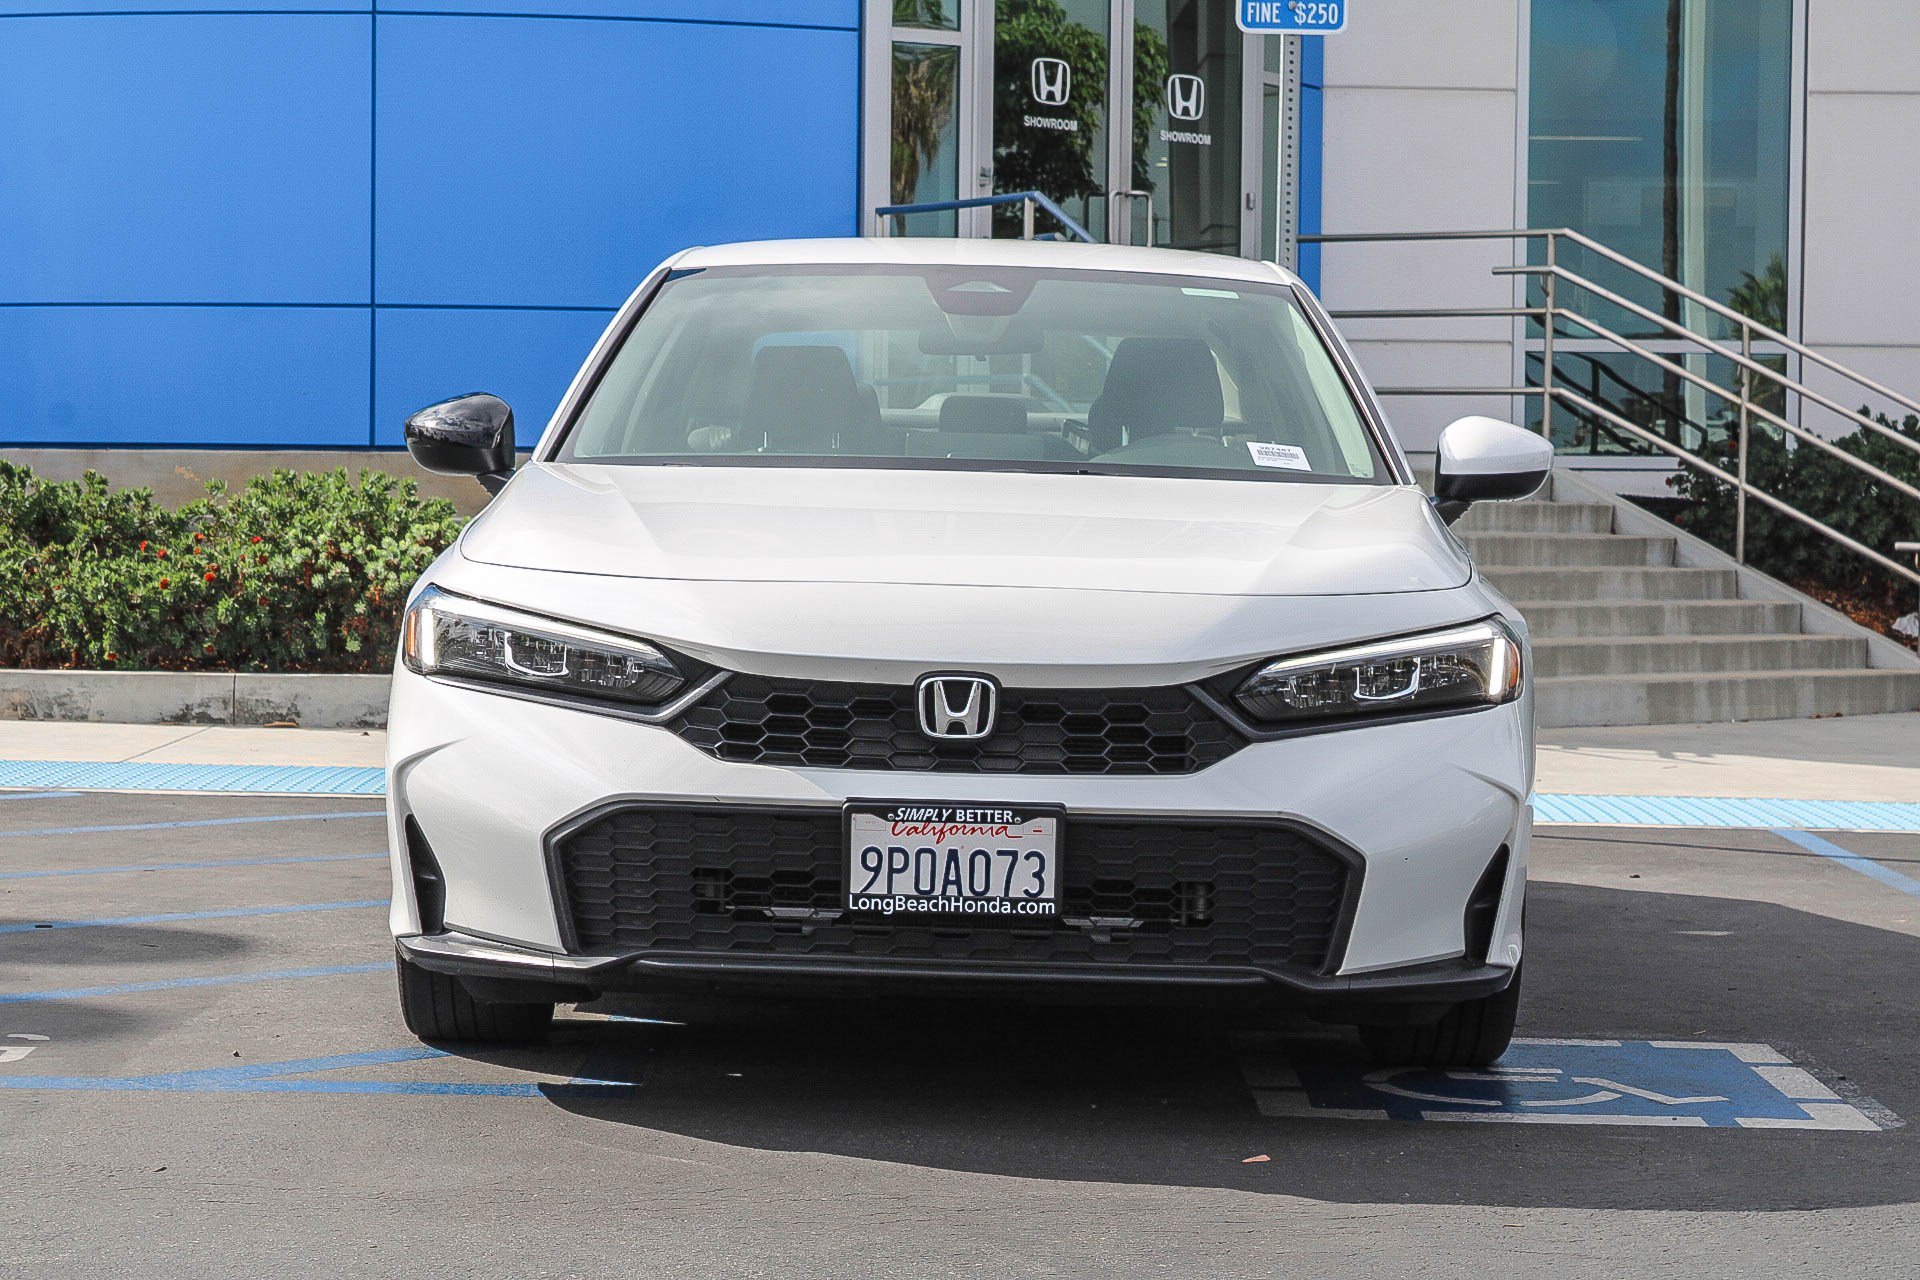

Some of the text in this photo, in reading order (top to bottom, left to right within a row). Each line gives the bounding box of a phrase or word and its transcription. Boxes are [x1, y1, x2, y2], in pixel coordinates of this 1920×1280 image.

[1247, 2, 1339, 26] FINE $250
[1023, 115, 1078, 132] SHOWROOM
[1160, 130, 1212, 145] SHOWROOM
[895, 807, 1013, 823] SIMPLY BETTER
[891, 821, 1023, 845] California
[849, 894, 1055, 915] LongBeachHonda.com
